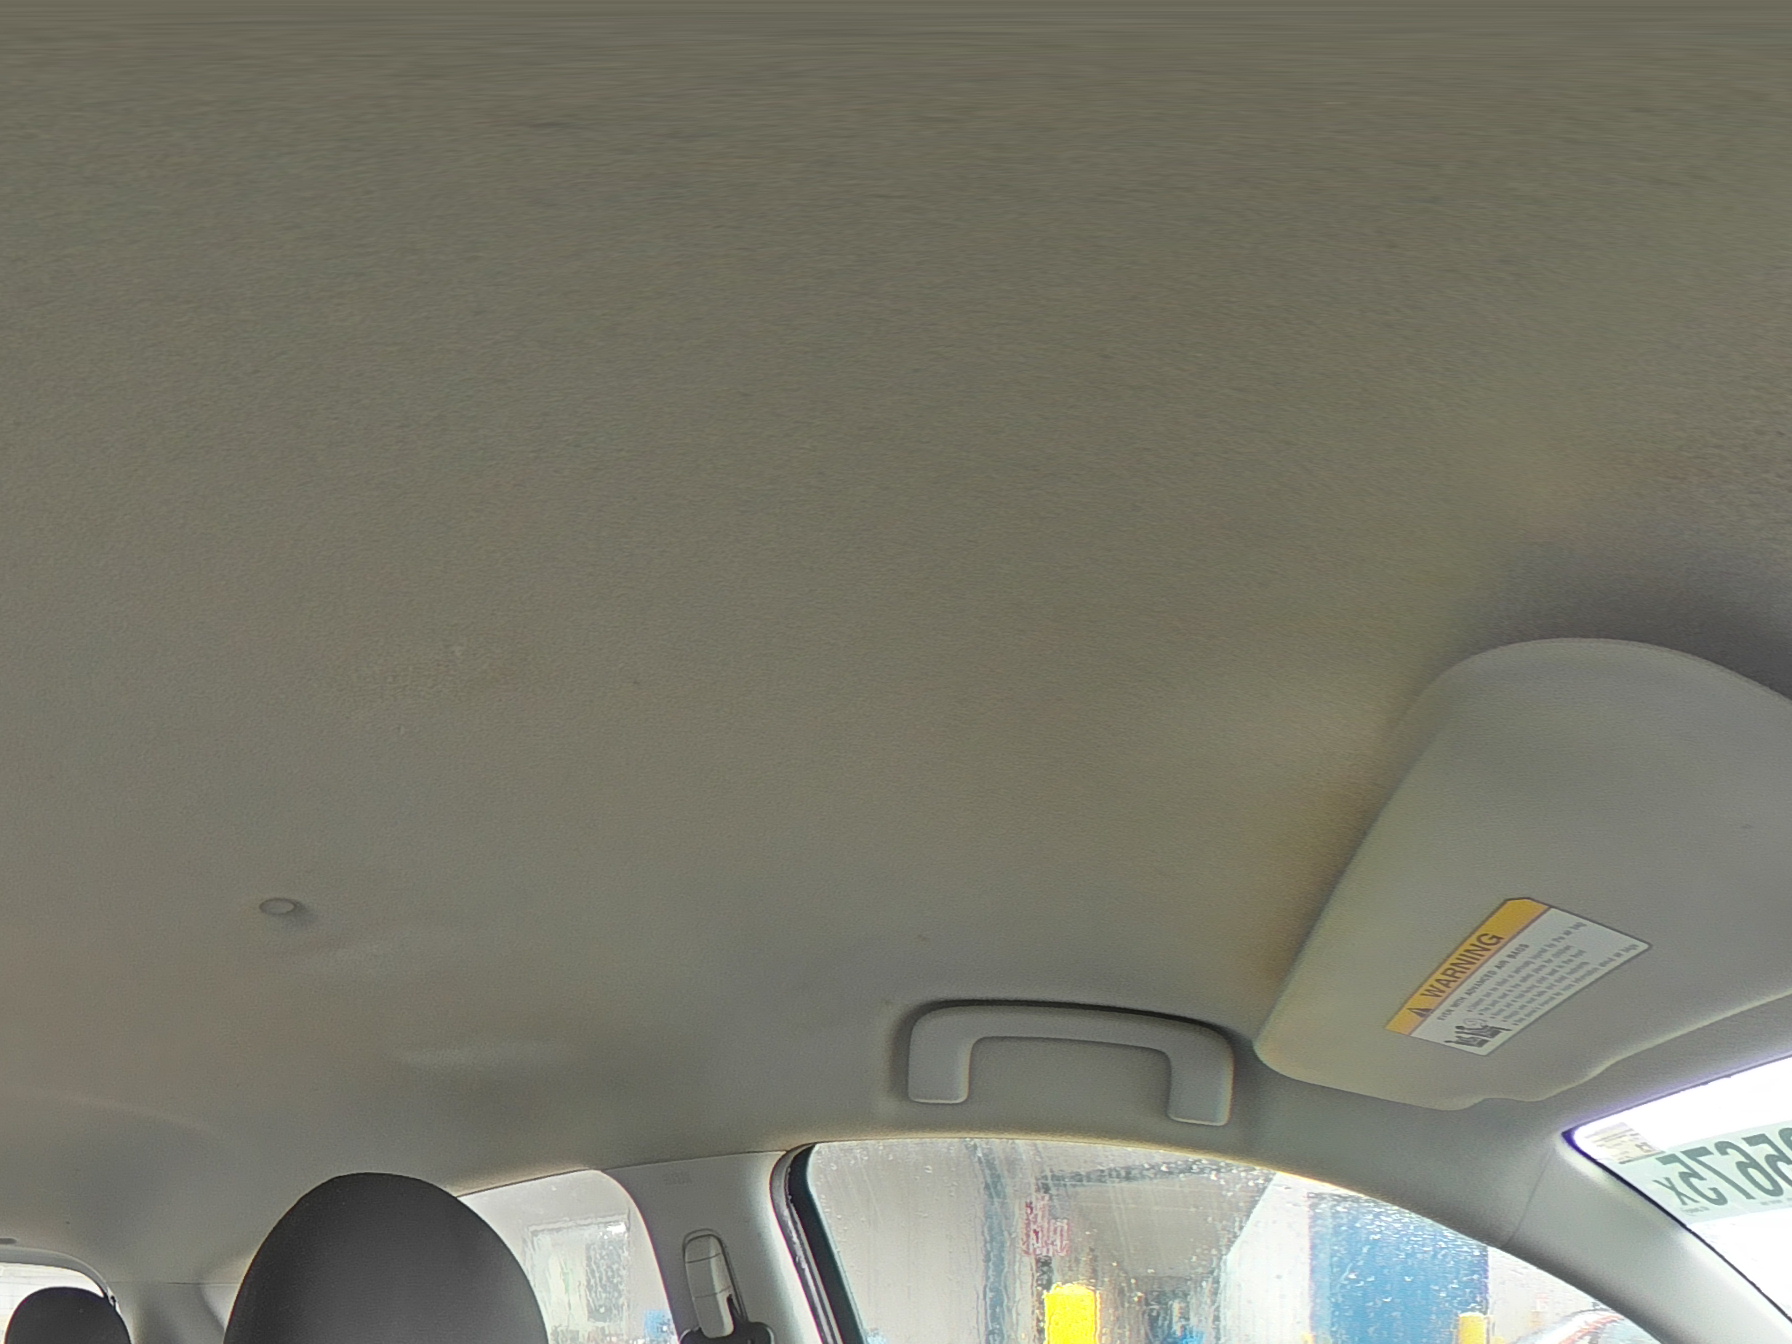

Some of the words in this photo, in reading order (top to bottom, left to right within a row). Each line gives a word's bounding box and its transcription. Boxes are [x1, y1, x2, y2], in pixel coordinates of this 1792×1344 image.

[1421, 932, 1504, 998] WARNING
[1463, 970, 1497, 996] ADVANCED
[1493, 959, 1510, 970] AIR
